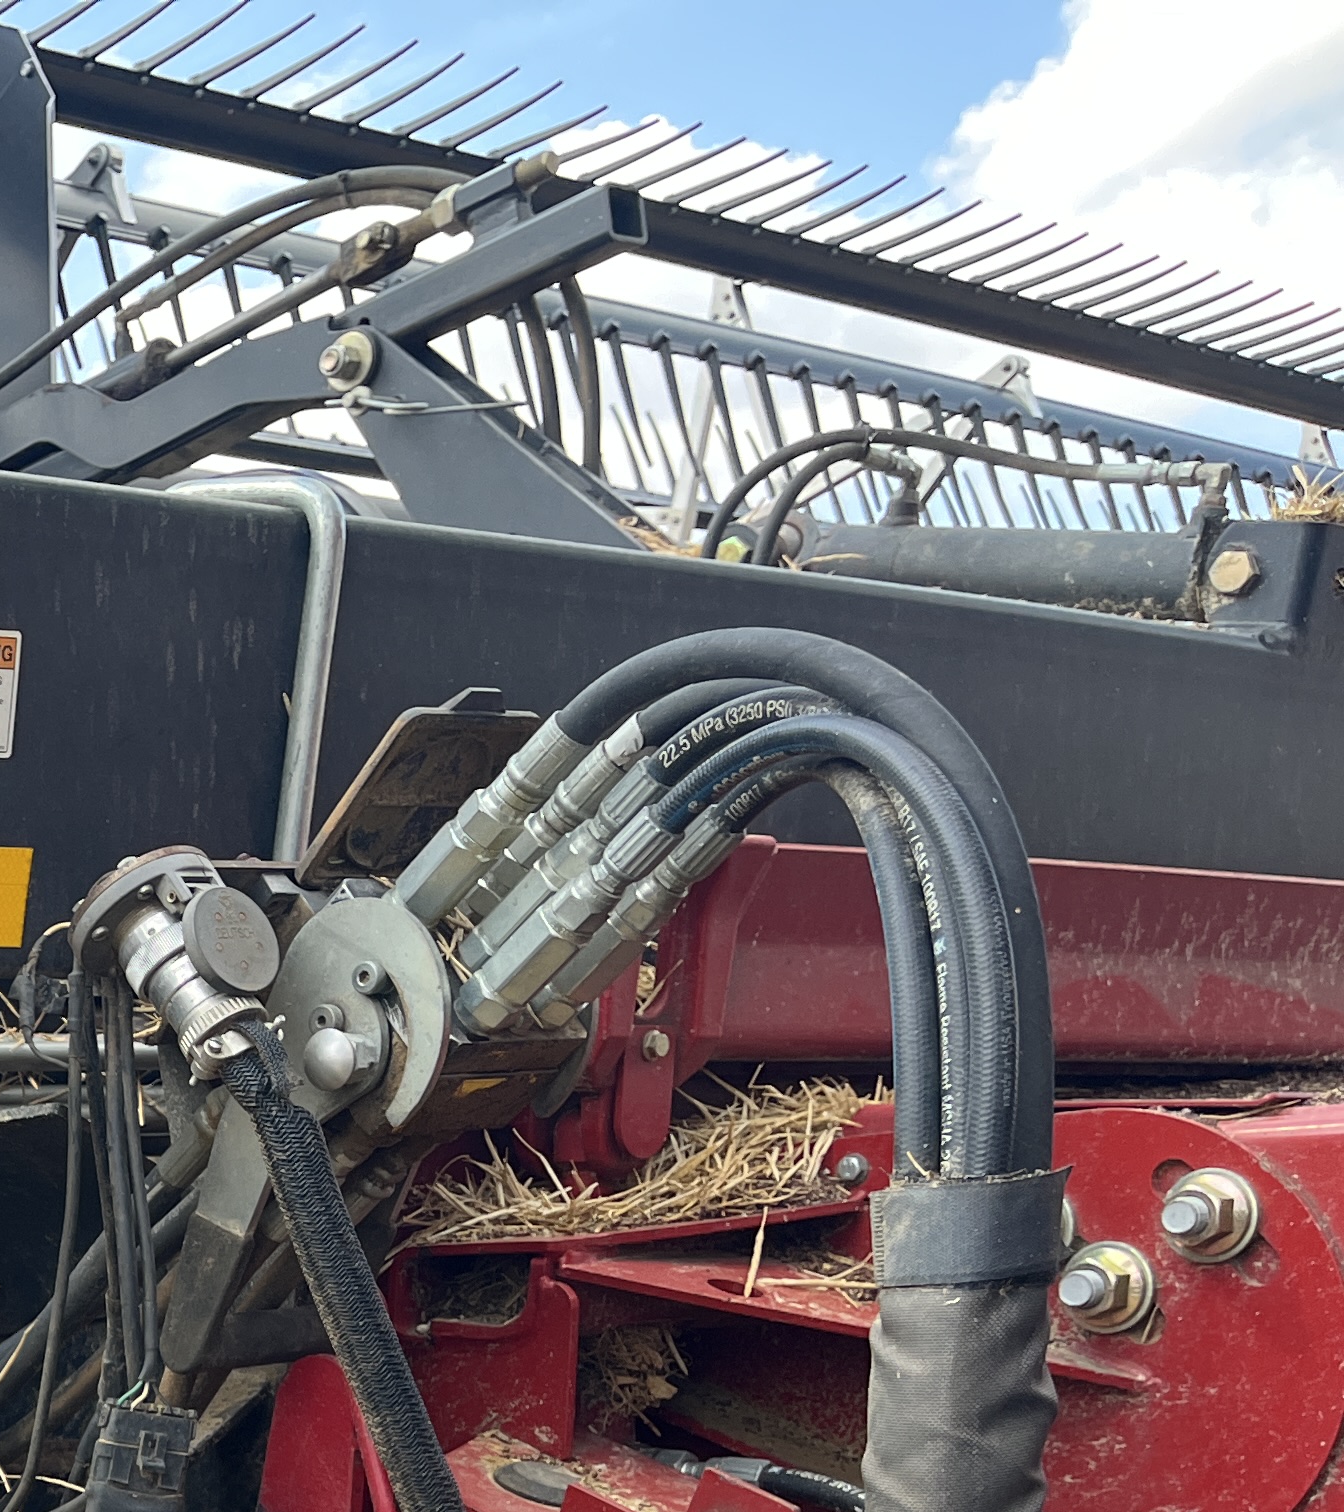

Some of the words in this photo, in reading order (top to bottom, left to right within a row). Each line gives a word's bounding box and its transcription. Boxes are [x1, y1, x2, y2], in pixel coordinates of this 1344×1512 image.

[659, 738, 691, 769] 22.5
[690, 717, 725, 743] MPa
[724, 702, 762, 727] (3250
[724, 784, 761, 822] 100R17
[913, 841, 930, 872] SAE
[921, 873, 942, 933] 100R17
[936, 962, 948, 1014] Flame
[940, 1015, 952, 1091] Resistant
